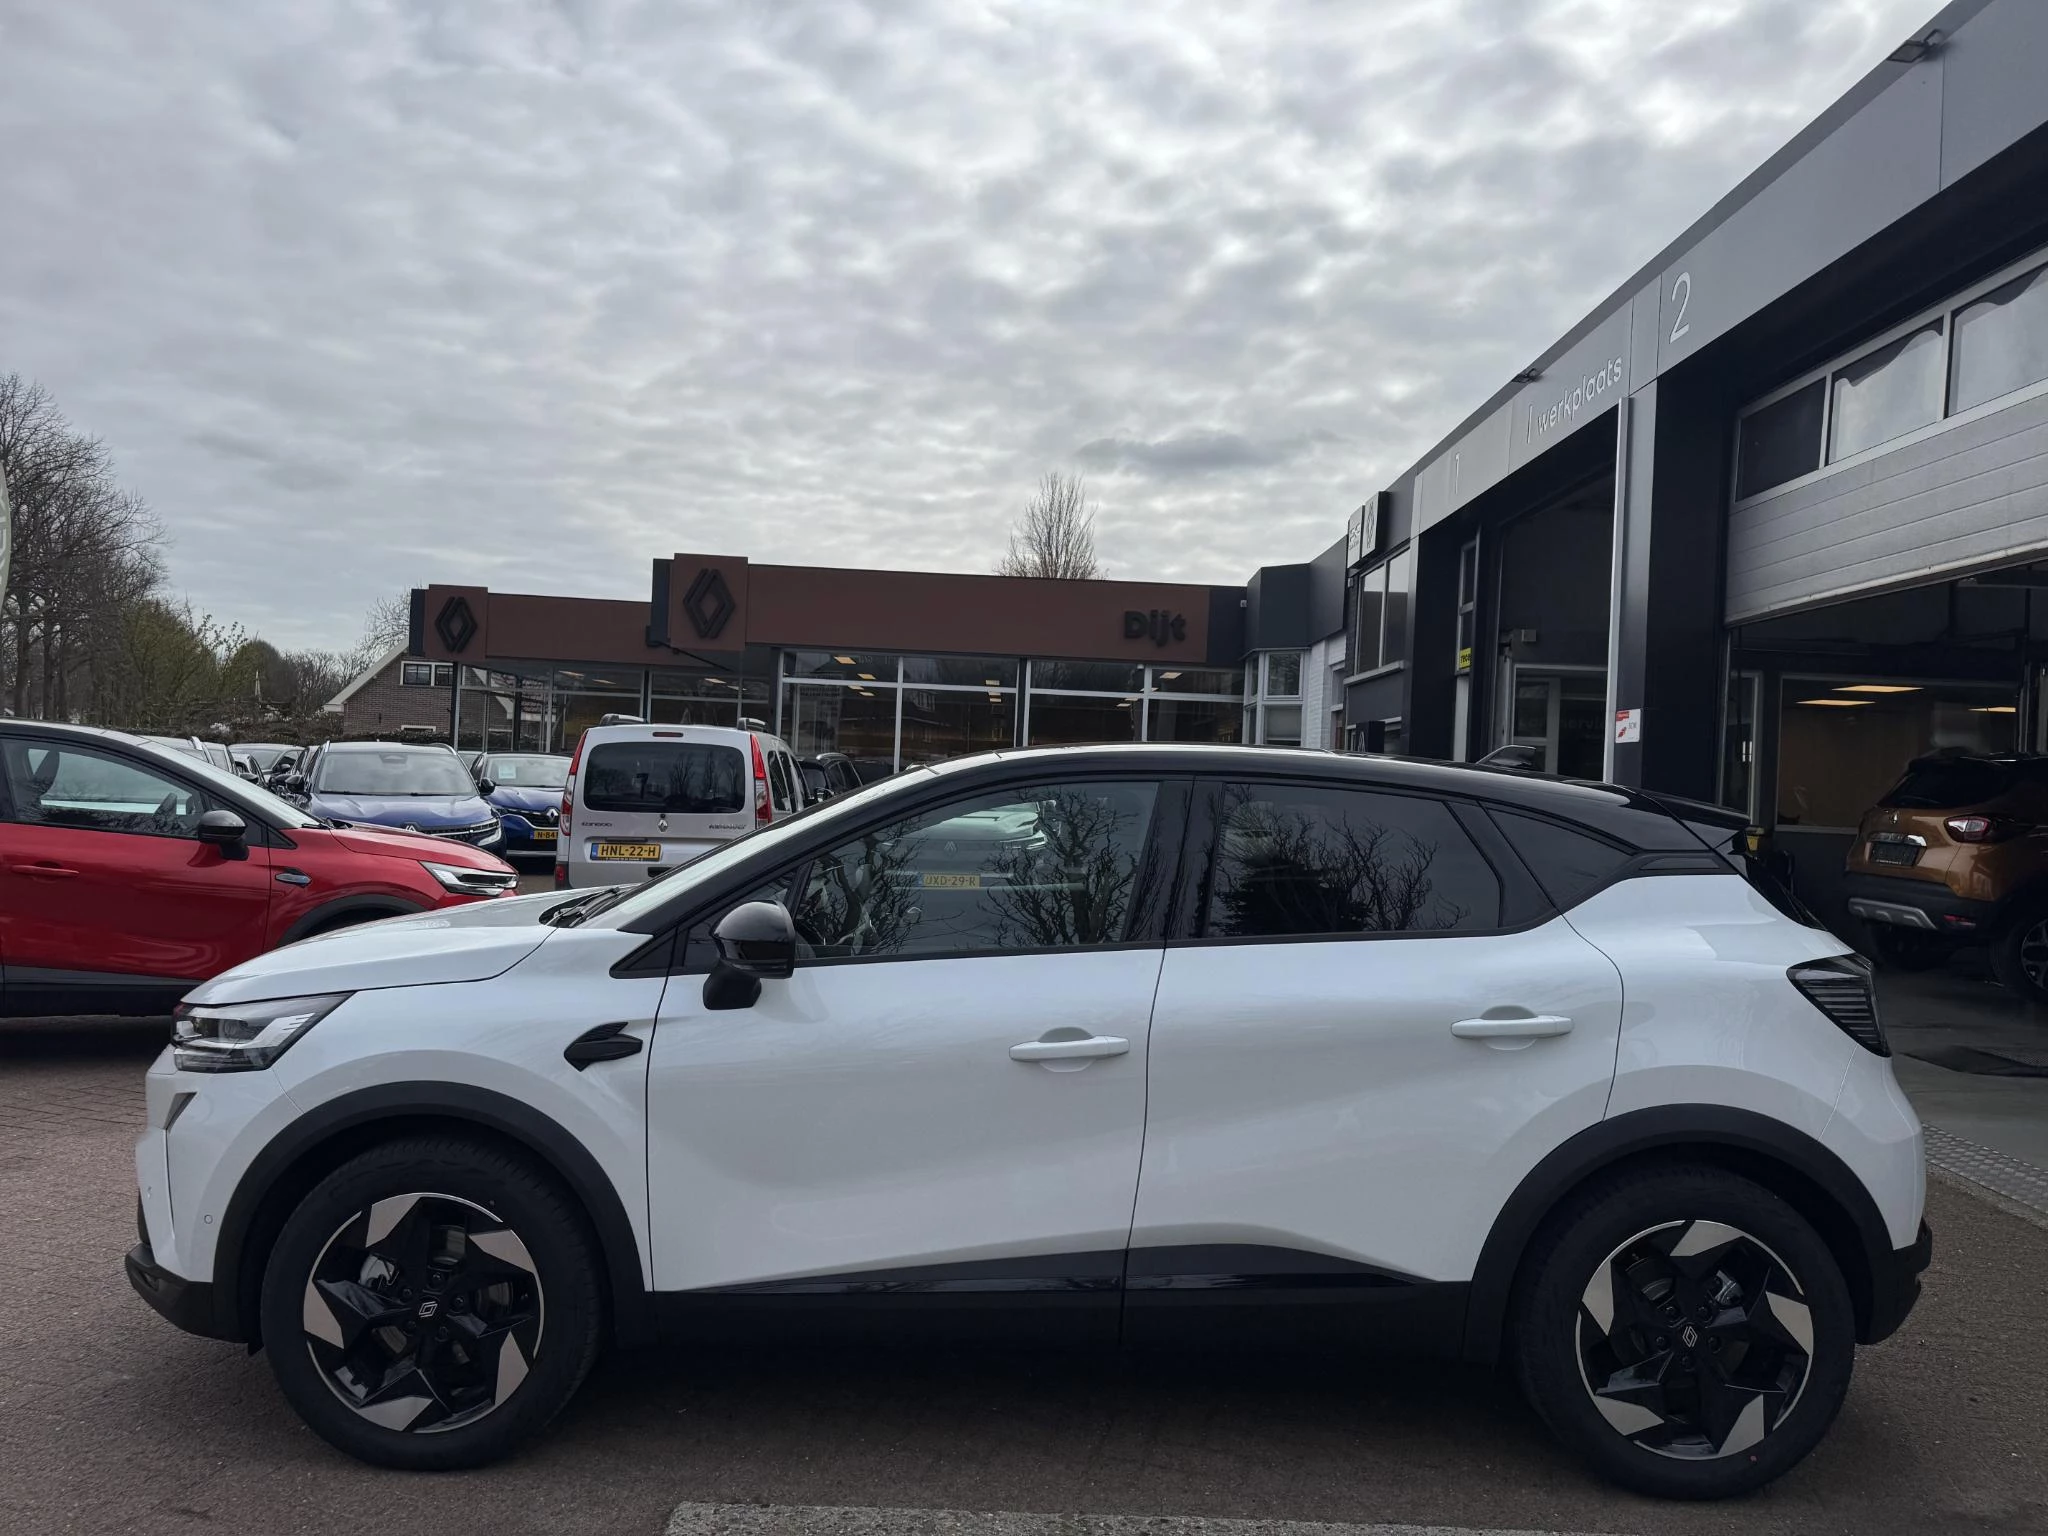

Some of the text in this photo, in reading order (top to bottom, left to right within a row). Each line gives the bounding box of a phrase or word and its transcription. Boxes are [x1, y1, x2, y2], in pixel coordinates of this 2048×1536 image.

[1669, 271, 1691, 345] 2
[1537, 356, 1622, 436] werkplaats
[1124, 608, 1187, 648] Dijt
[601, 845, 656, 857] HNL-22-H
